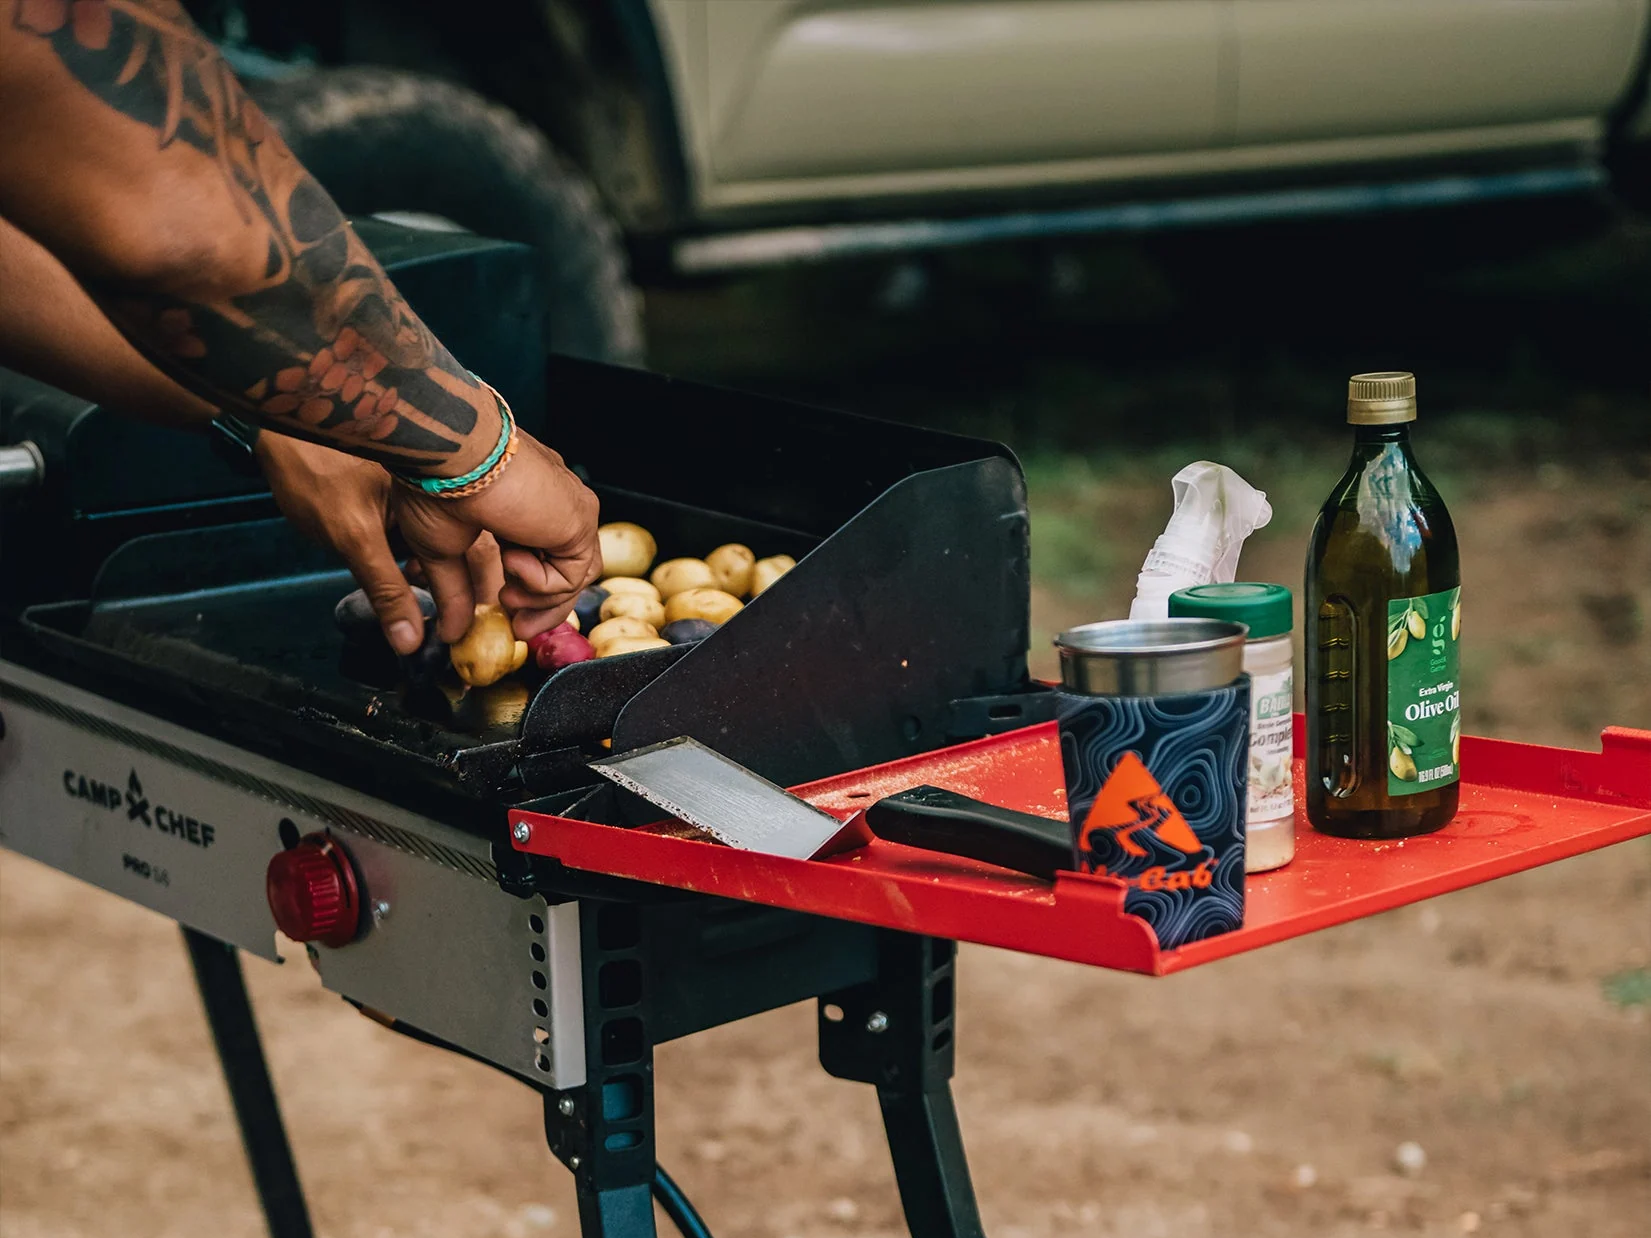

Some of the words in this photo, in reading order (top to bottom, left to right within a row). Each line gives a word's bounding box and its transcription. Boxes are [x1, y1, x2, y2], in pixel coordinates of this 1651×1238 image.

[1405, 700, 1445, 721] Olive
[1445, 690, 1460, 712] Oil
[1419, 687, 1437, 697] Extra
[63, 769, 122, 812] CAMP
[154, 805, 216, 849] CHEF
[123, 853, 151, 880] PRO
